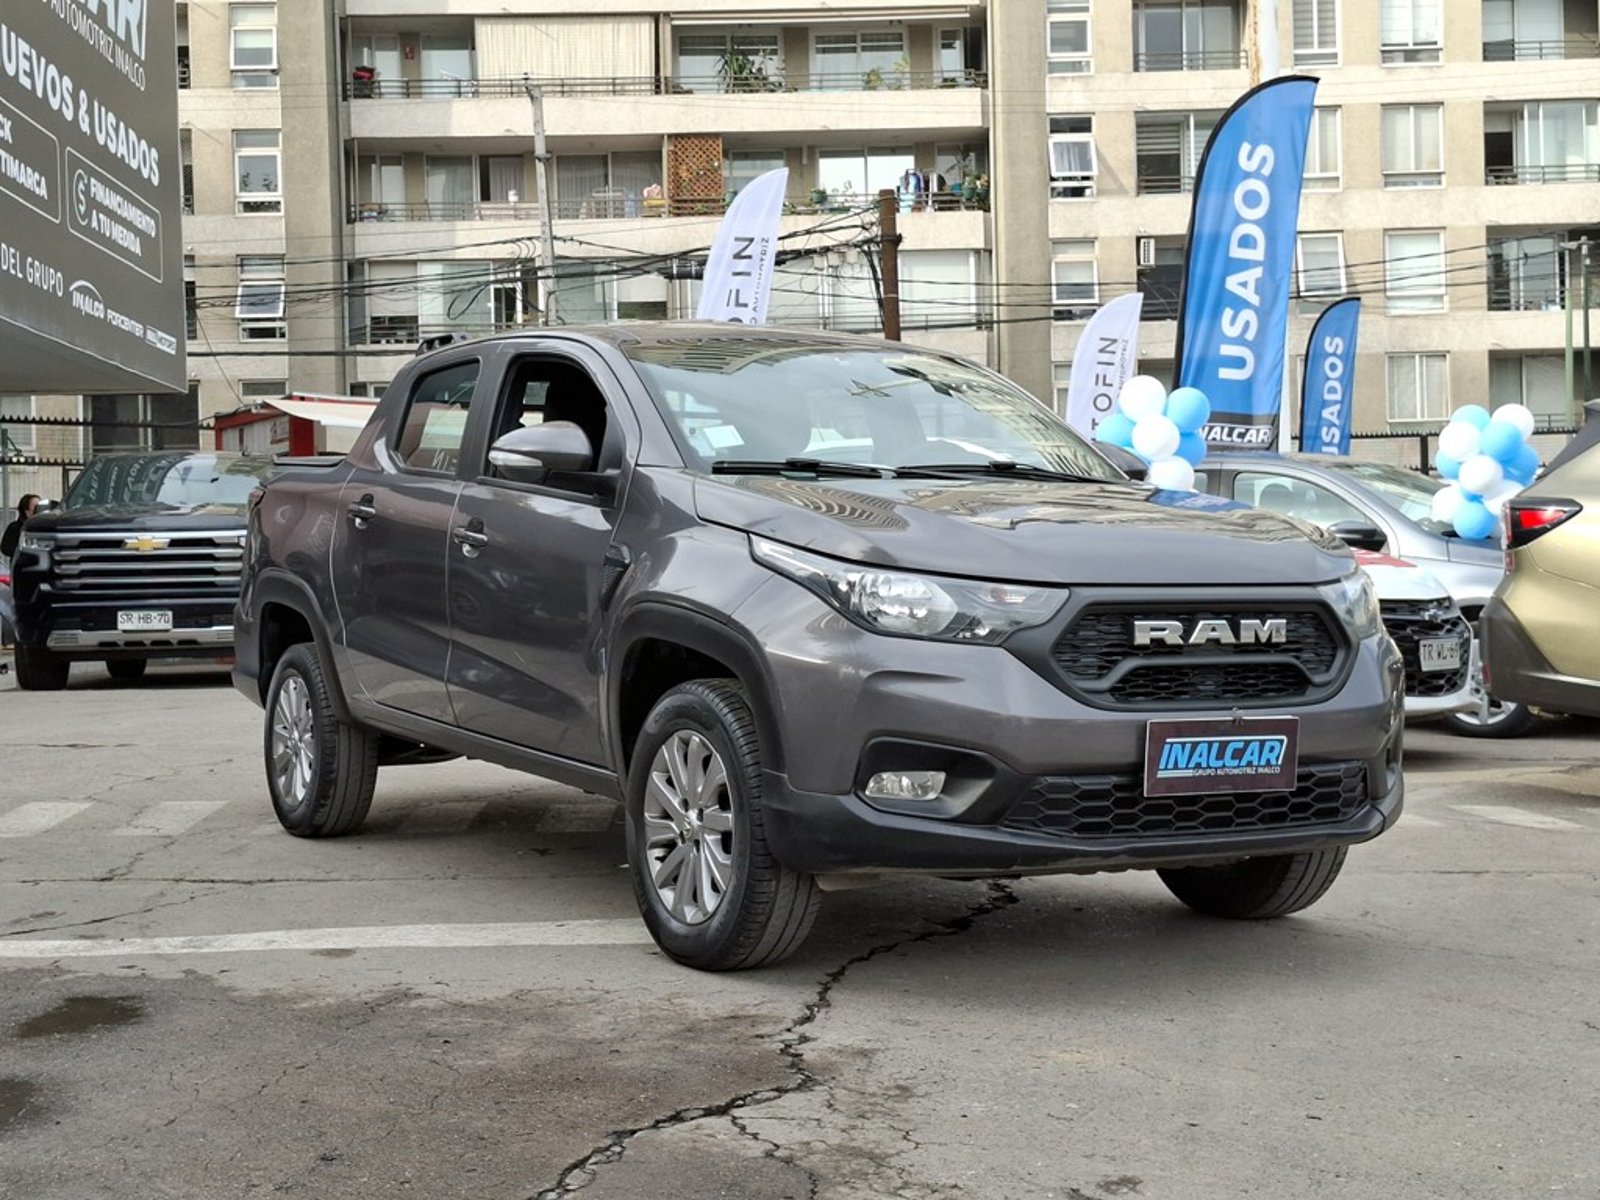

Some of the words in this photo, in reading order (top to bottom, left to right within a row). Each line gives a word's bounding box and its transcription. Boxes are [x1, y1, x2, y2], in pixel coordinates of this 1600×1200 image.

[0, 23, 74, 121] UEVOS
[78, 89, 91, 136] &
[93, 98, 160, 187] USADOS
[0, 113, 13, 144] CK
[0, 148, 48, 200] TIMARCA
[91, 209, 99, 231] A
[99, 212, 111, 238] TU
[111, 220, 142, 257] MEDIDA
[1, 243, 23, 279] DEL
[26, 257, 64, 297] GRUPO
[1218, 141, 1275, 380] USADOS
[1091, 337, 1118, 442] TOFIN
[1198, 426, 1271, 443] NALCAR
[1133, 619, 1287, 645] RAM
[1159, 741, 1281, 769] INALCAR
